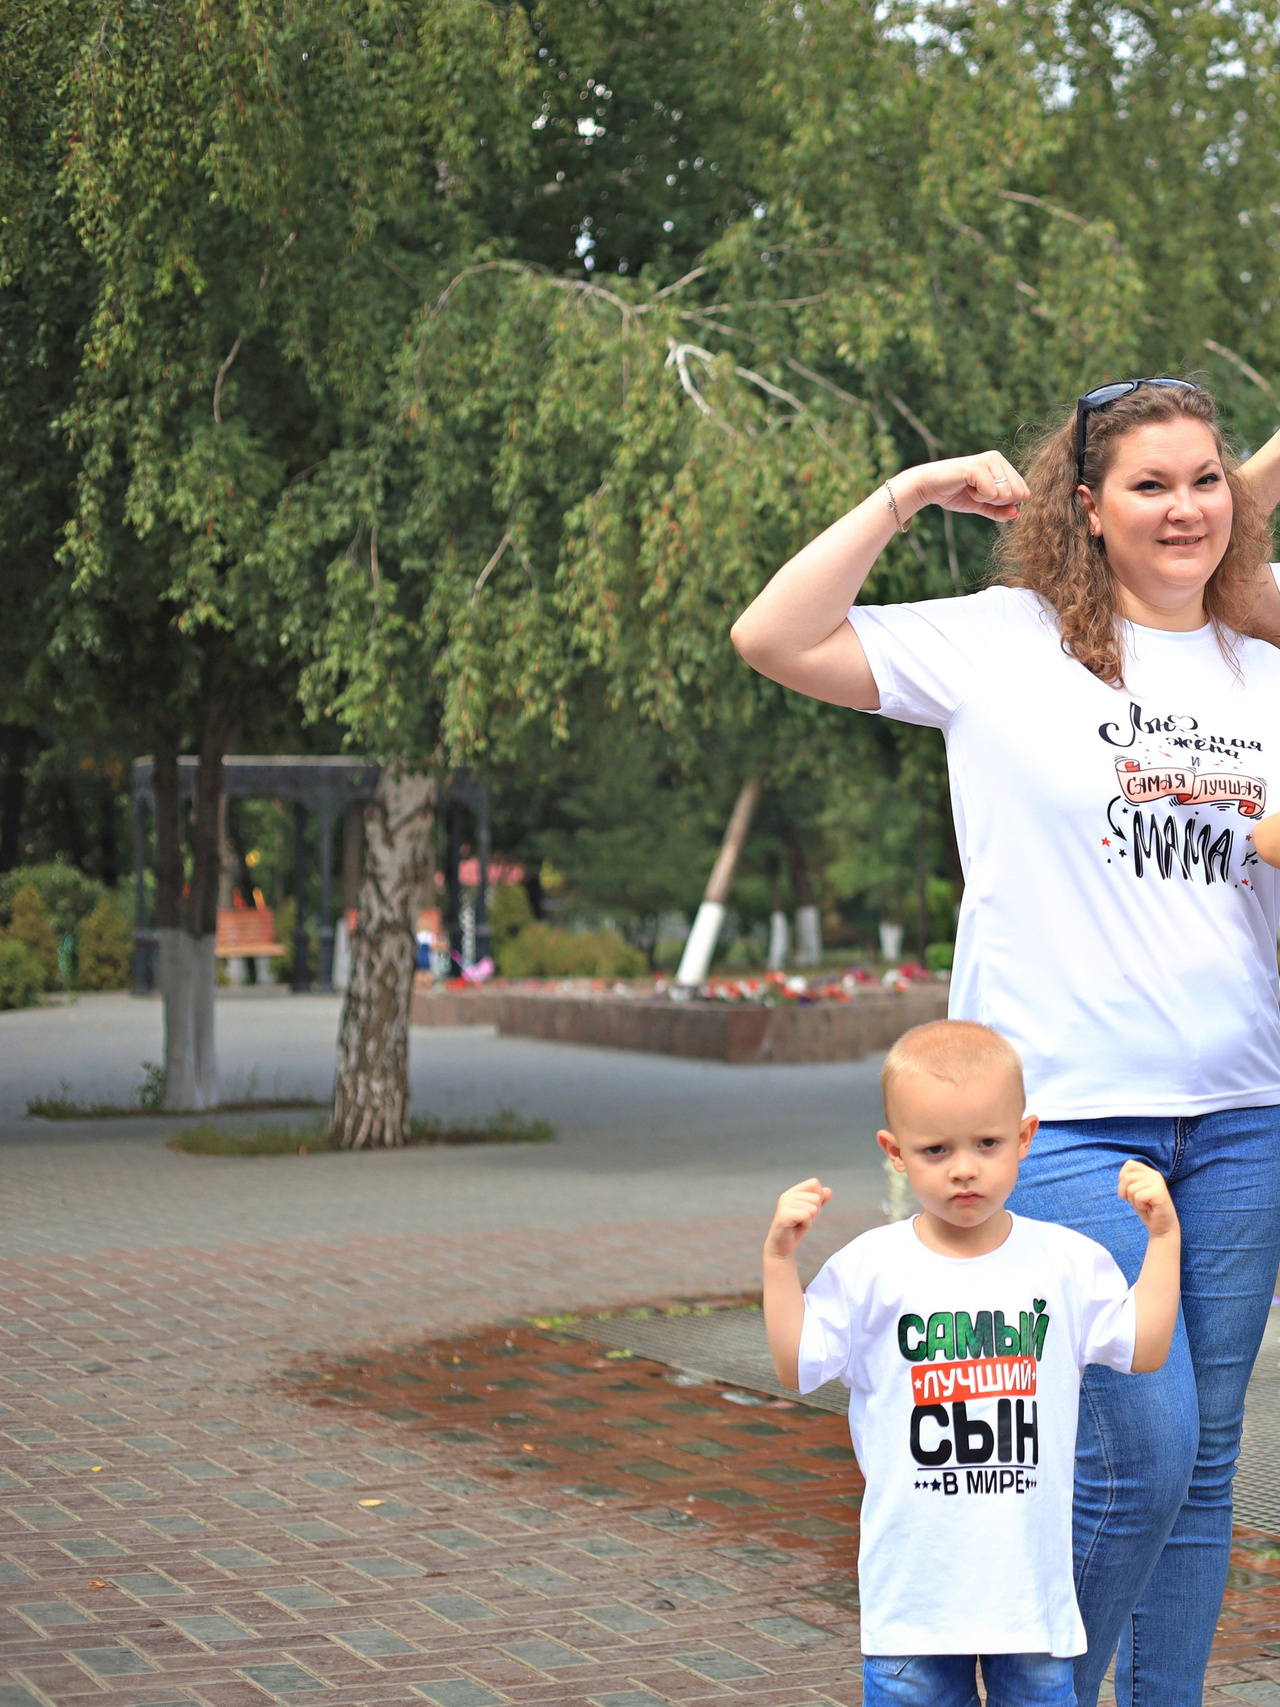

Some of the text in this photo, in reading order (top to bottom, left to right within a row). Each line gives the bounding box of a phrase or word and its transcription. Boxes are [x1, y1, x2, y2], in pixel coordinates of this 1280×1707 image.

[1126, 773, 1263, 800] САМАЯ ЛУЧШАЯ
[1132, 810, 1235, 885] МАМА
[898, 1298, 1050, 1362] САМЫЙ
[923, 1359, 1032, 1399] ЛУЧШИЙ
[909, 1398, 1039, 1466] СЫН
[942, 1470, 1025, 1496] В МИРЕ
